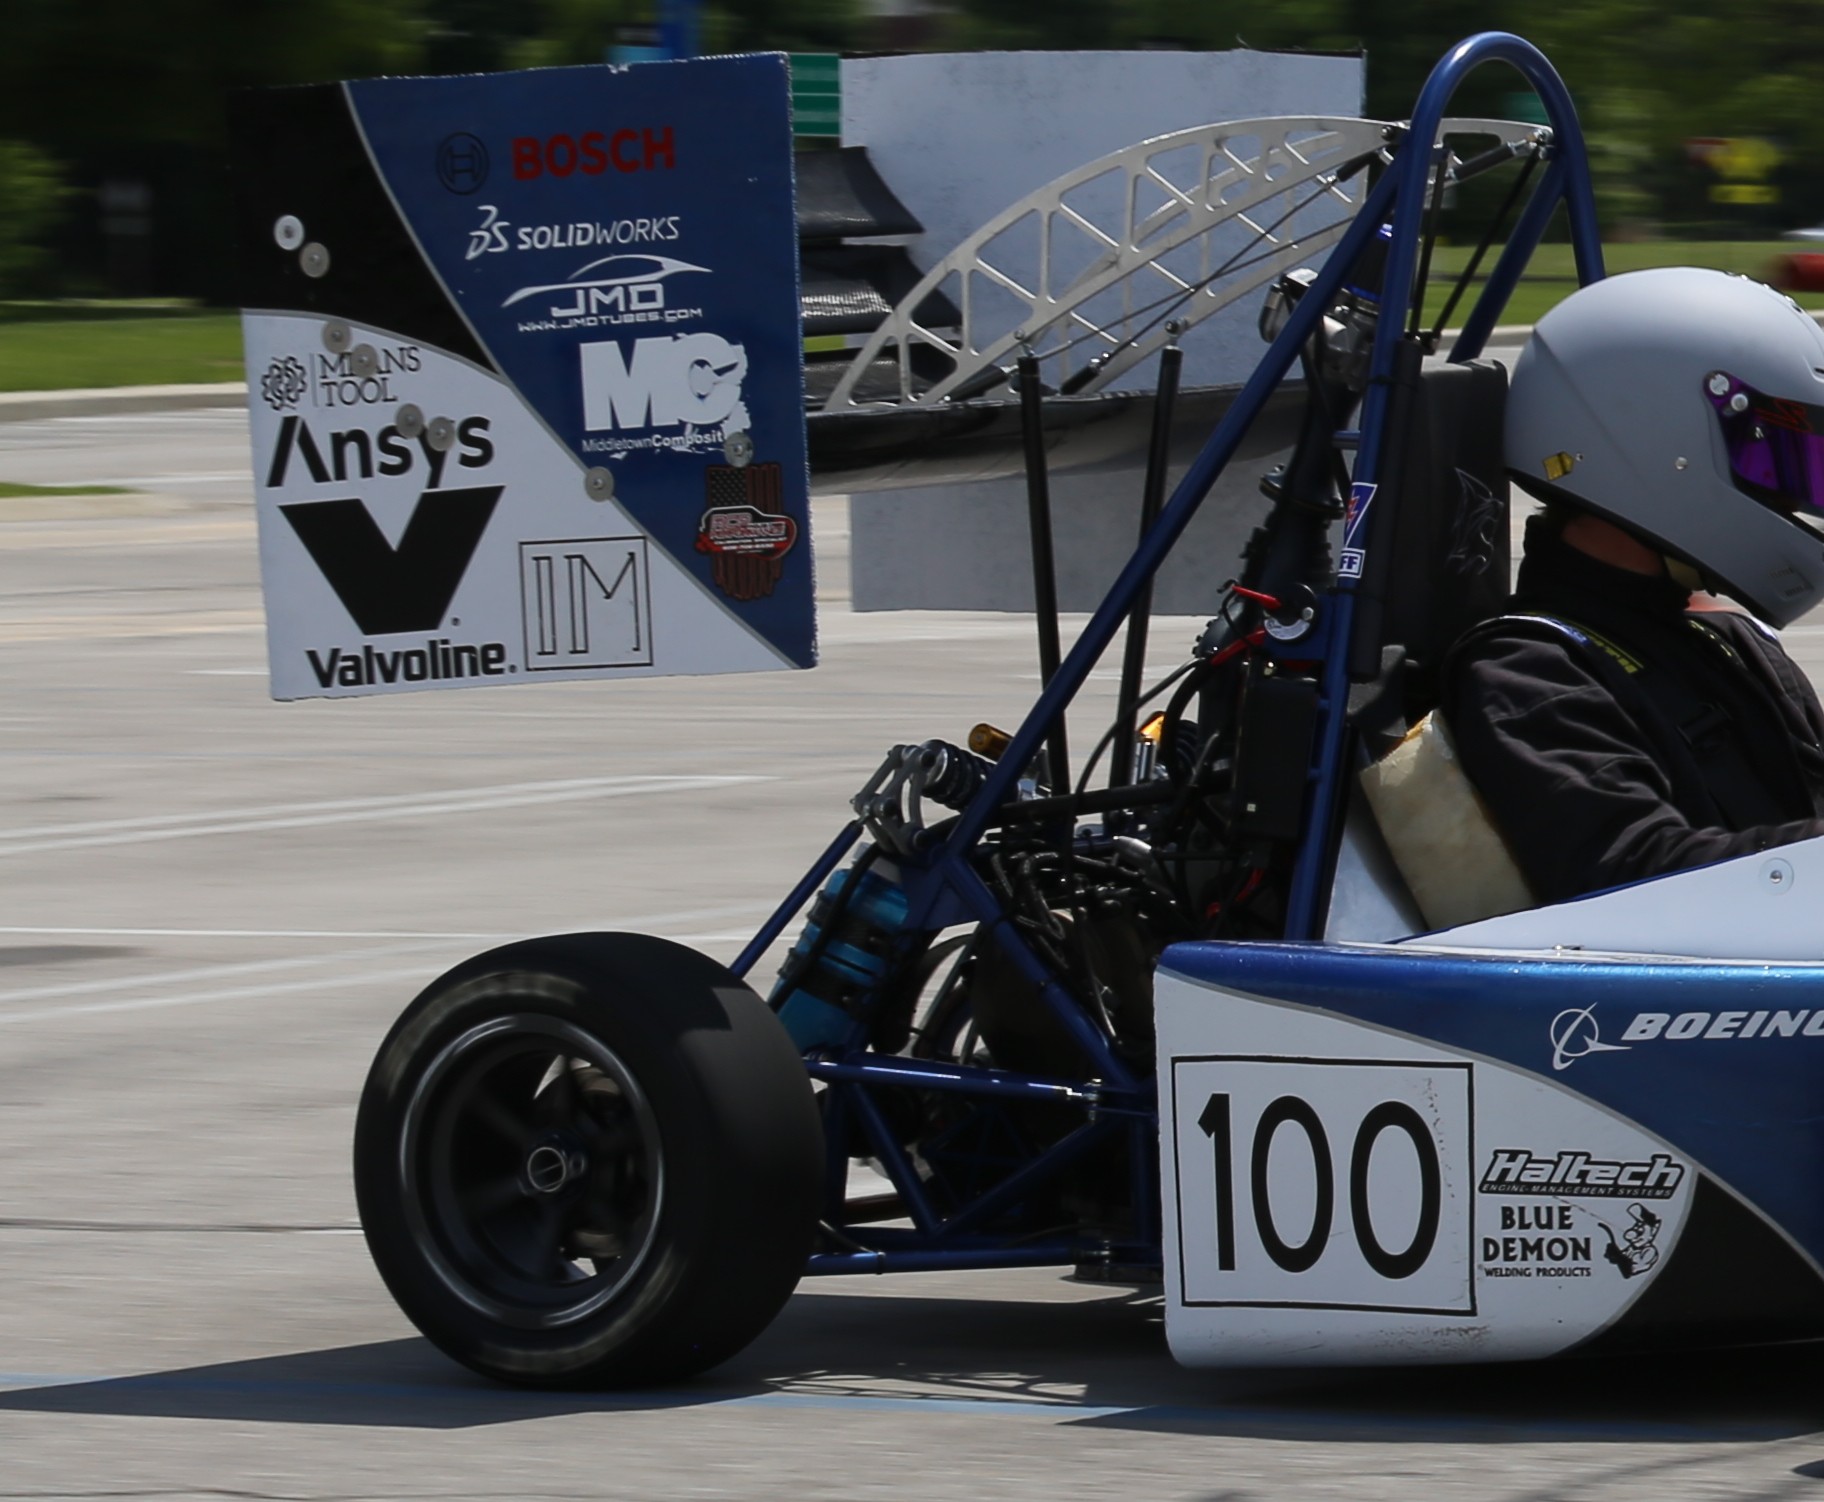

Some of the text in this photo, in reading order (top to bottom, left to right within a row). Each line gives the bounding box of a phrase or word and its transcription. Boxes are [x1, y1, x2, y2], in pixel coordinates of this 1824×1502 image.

[511, 126, 676, 181] BOSCH
[517, 216, 680, 250] SOLIDWORKS
[551, 283, 664, 317] JMD
[318, 346, 421, 379] MNS
[320, 376, 398, 407] TOOL
[307, 639, 506, 688] Valvoline
[1197, 1093, 1441, 1279] 100
[1486, 1152, 1682, 1187] Haltech
[1531, 1185, 1613, 1195] MANAGEMENT
[1617, 1188, 1671, 1197] SYSTEMS
[1501, 1206, 1574, 1230] BLUE
[1483, 1237, 1591, 1262] DEMON
[1484, 1267, 1591, 1277] WELDING PRODUCTS
